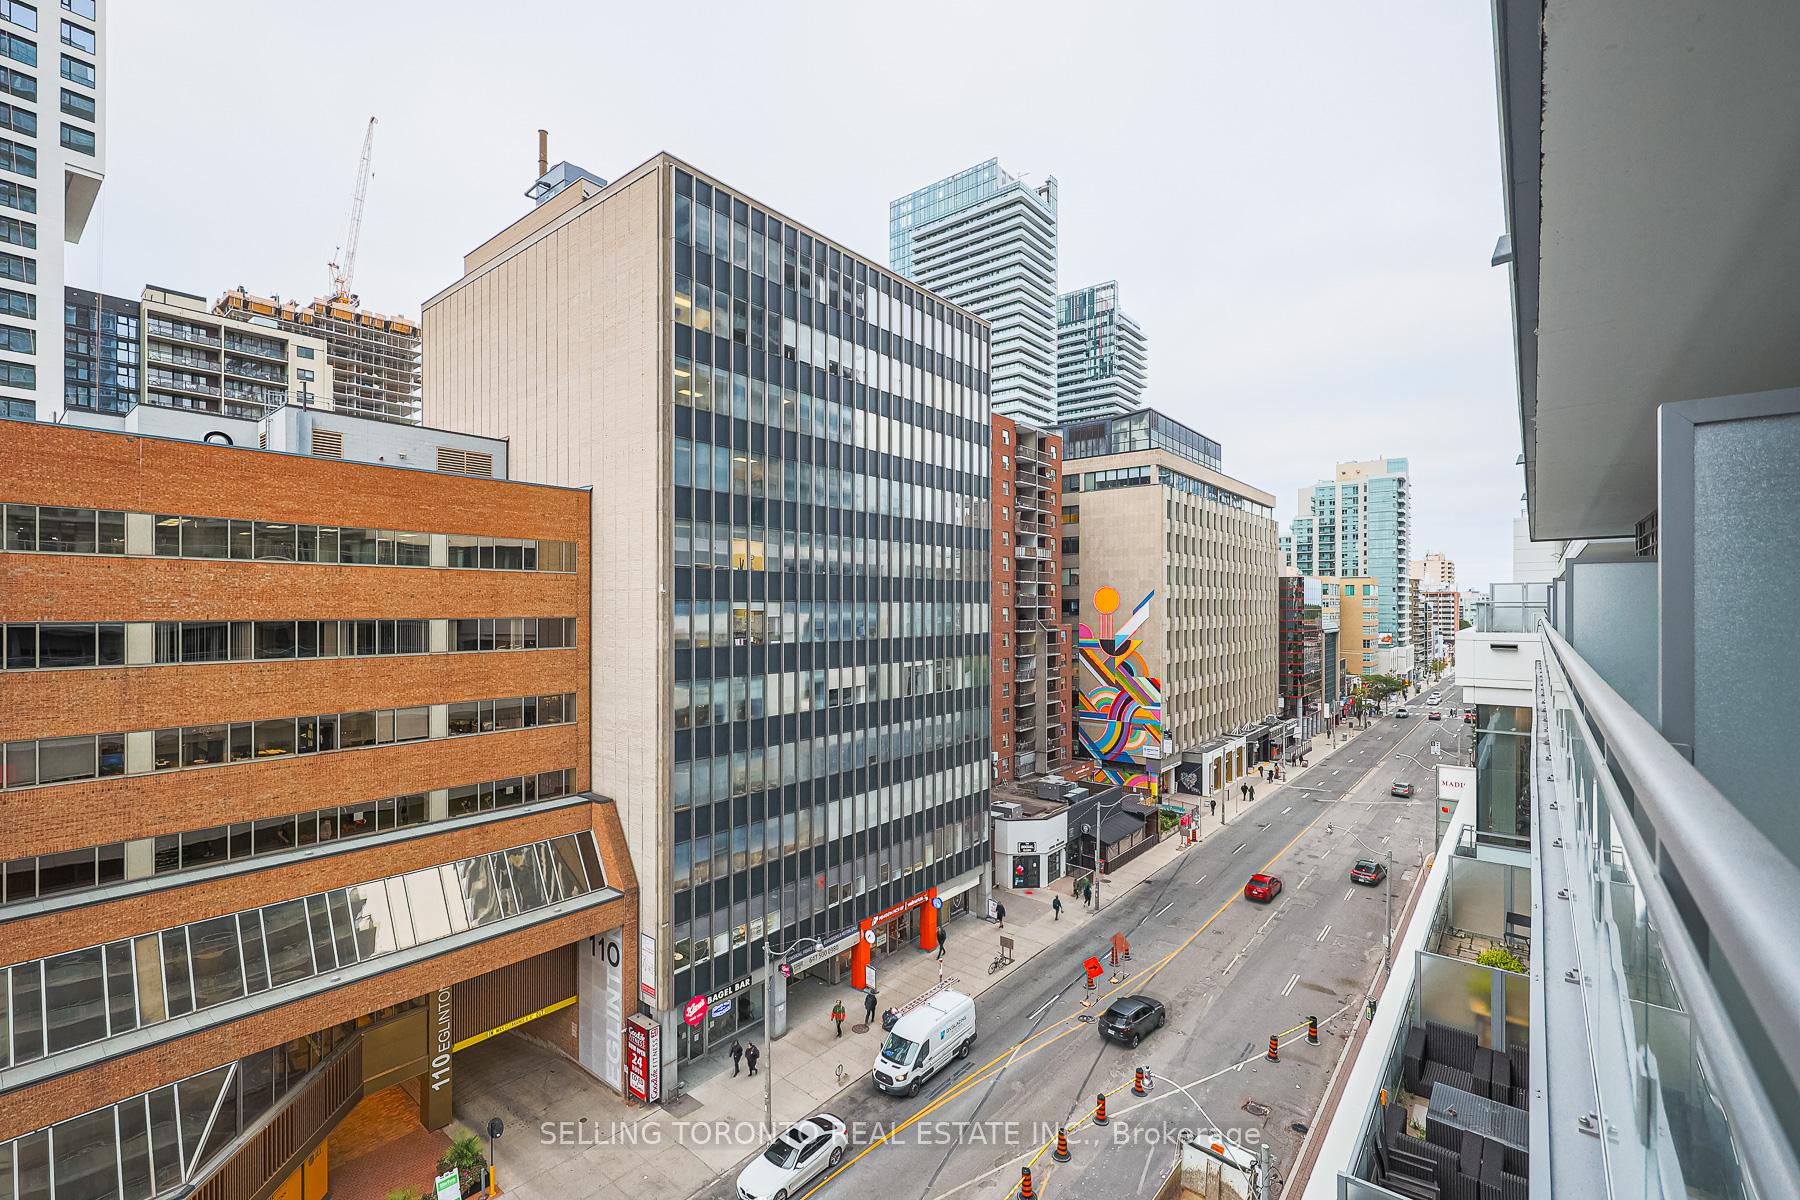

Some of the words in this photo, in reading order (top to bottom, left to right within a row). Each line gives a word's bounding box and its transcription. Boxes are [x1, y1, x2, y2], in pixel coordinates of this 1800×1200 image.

[707, 986, 733, 1005] BAGEL
[734, 978, 751, 992] BAR
[431, 1053, 451, 1091] 110
[631, 1053, 643, 1068] 24
